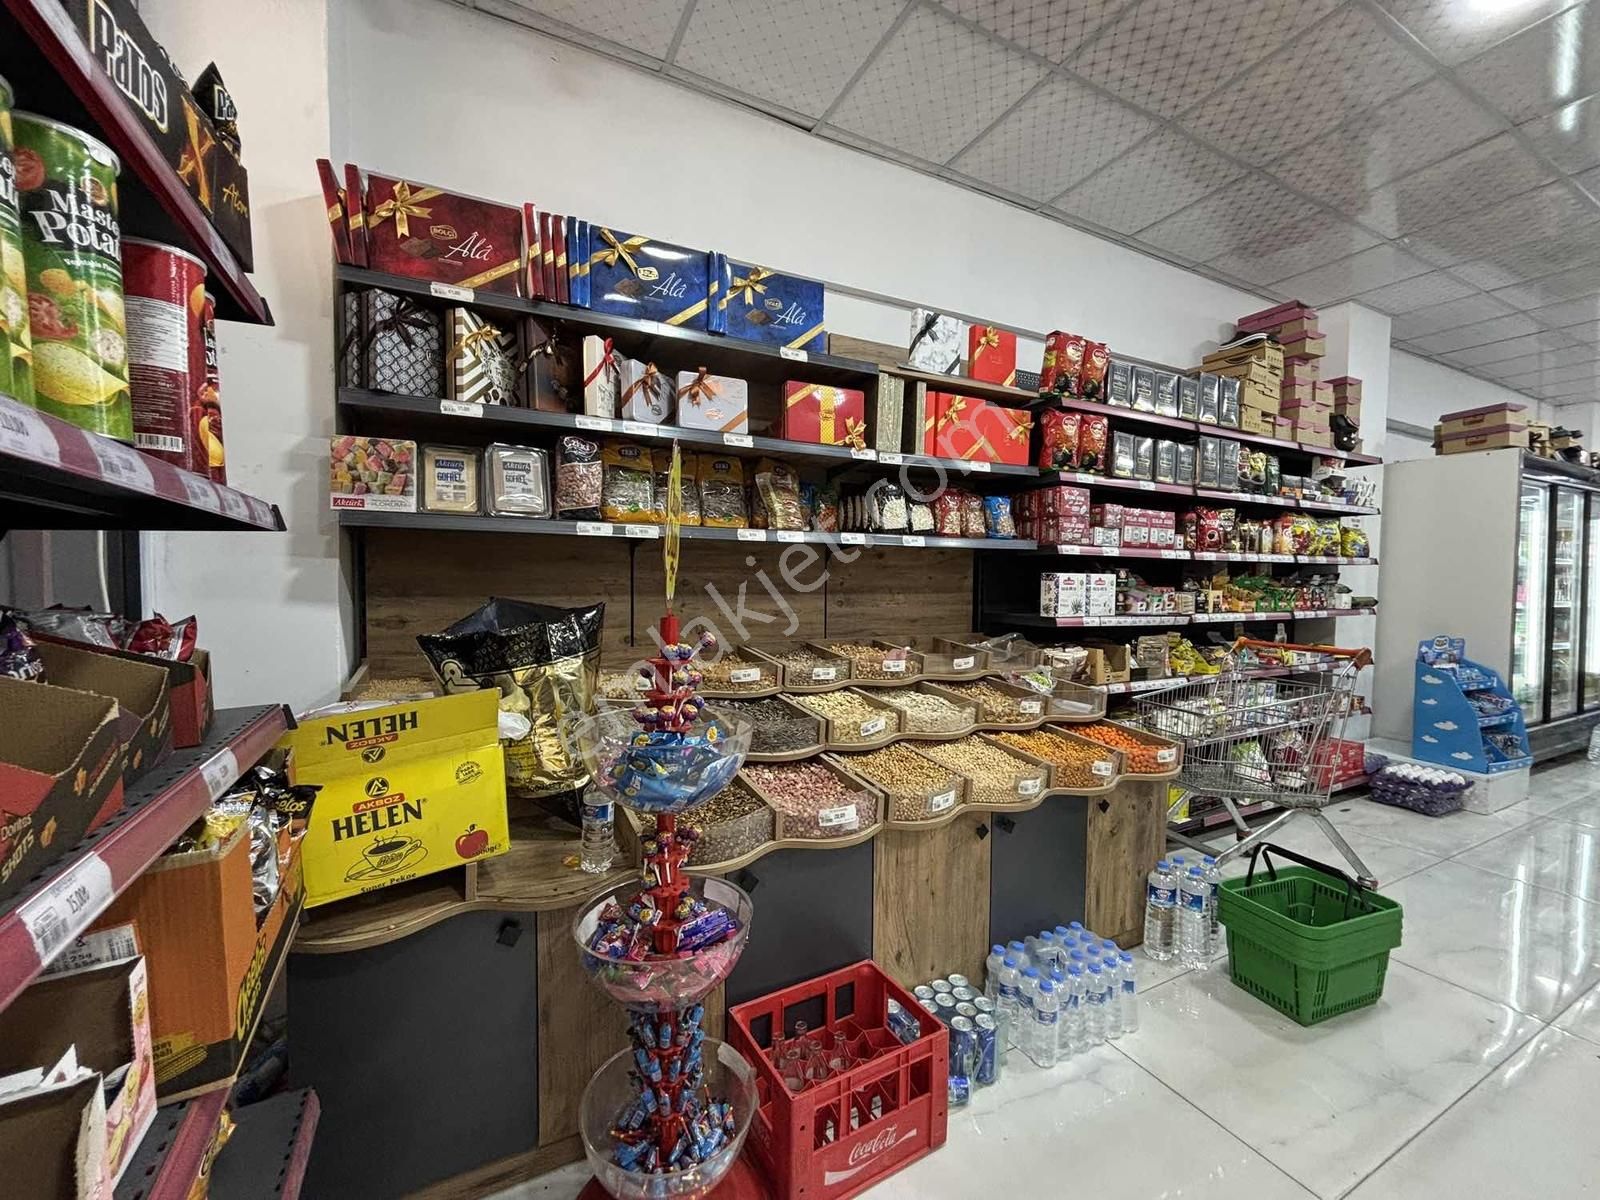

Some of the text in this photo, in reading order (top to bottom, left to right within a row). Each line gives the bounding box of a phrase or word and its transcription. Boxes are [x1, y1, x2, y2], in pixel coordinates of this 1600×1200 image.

[46, 188, 120, 236] Maste
[28, 210, 121, 262] Pota
[334, 499, 363, 507] Aktürk
[326, 711, 419, 745] HELEN
[350, 735, 394, 749] AKBOZ
[331, 799, 423, 842] HELEN
[357, 795, 402, 811] AKBOZ
[2, 828, 34, 884] SHOTS
